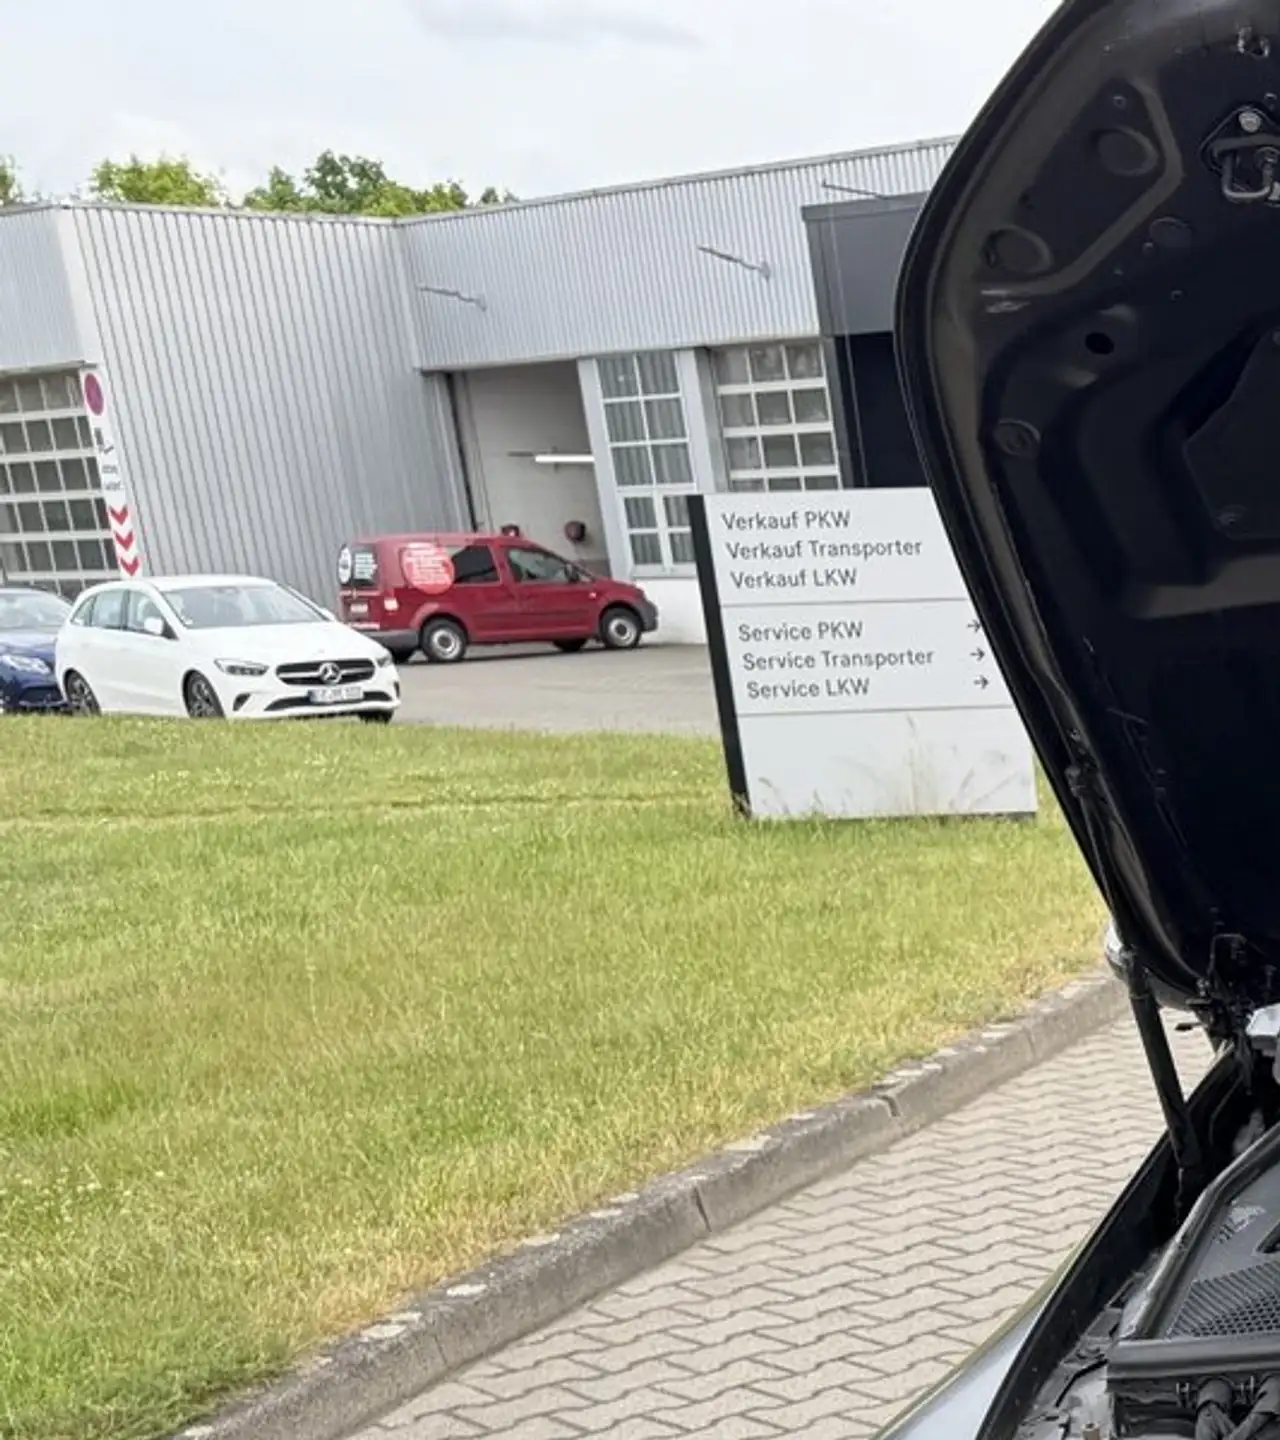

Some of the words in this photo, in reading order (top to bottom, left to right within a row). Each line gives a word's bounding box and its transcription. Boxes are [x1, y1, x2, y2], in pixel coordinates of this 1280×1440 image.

[721, 512, 799, 530] Verkauf
[804, 509, 851, 528] PKW
[725, 540, 803, 560] Verkauf
[809, 540, 923, 560] Transporter
[730, 569, 806, 589] Verkauf
[813, 567, 858, 586] LKW
[738, 622, 813, 642] Service
[818, 621, 863, 640] PKW
[742, 652, 817, 671] Service
[822, 650, 935, 670] Transporter
[746, 680, 820, 699] Service
[826, 679, 870, 697] LKW
